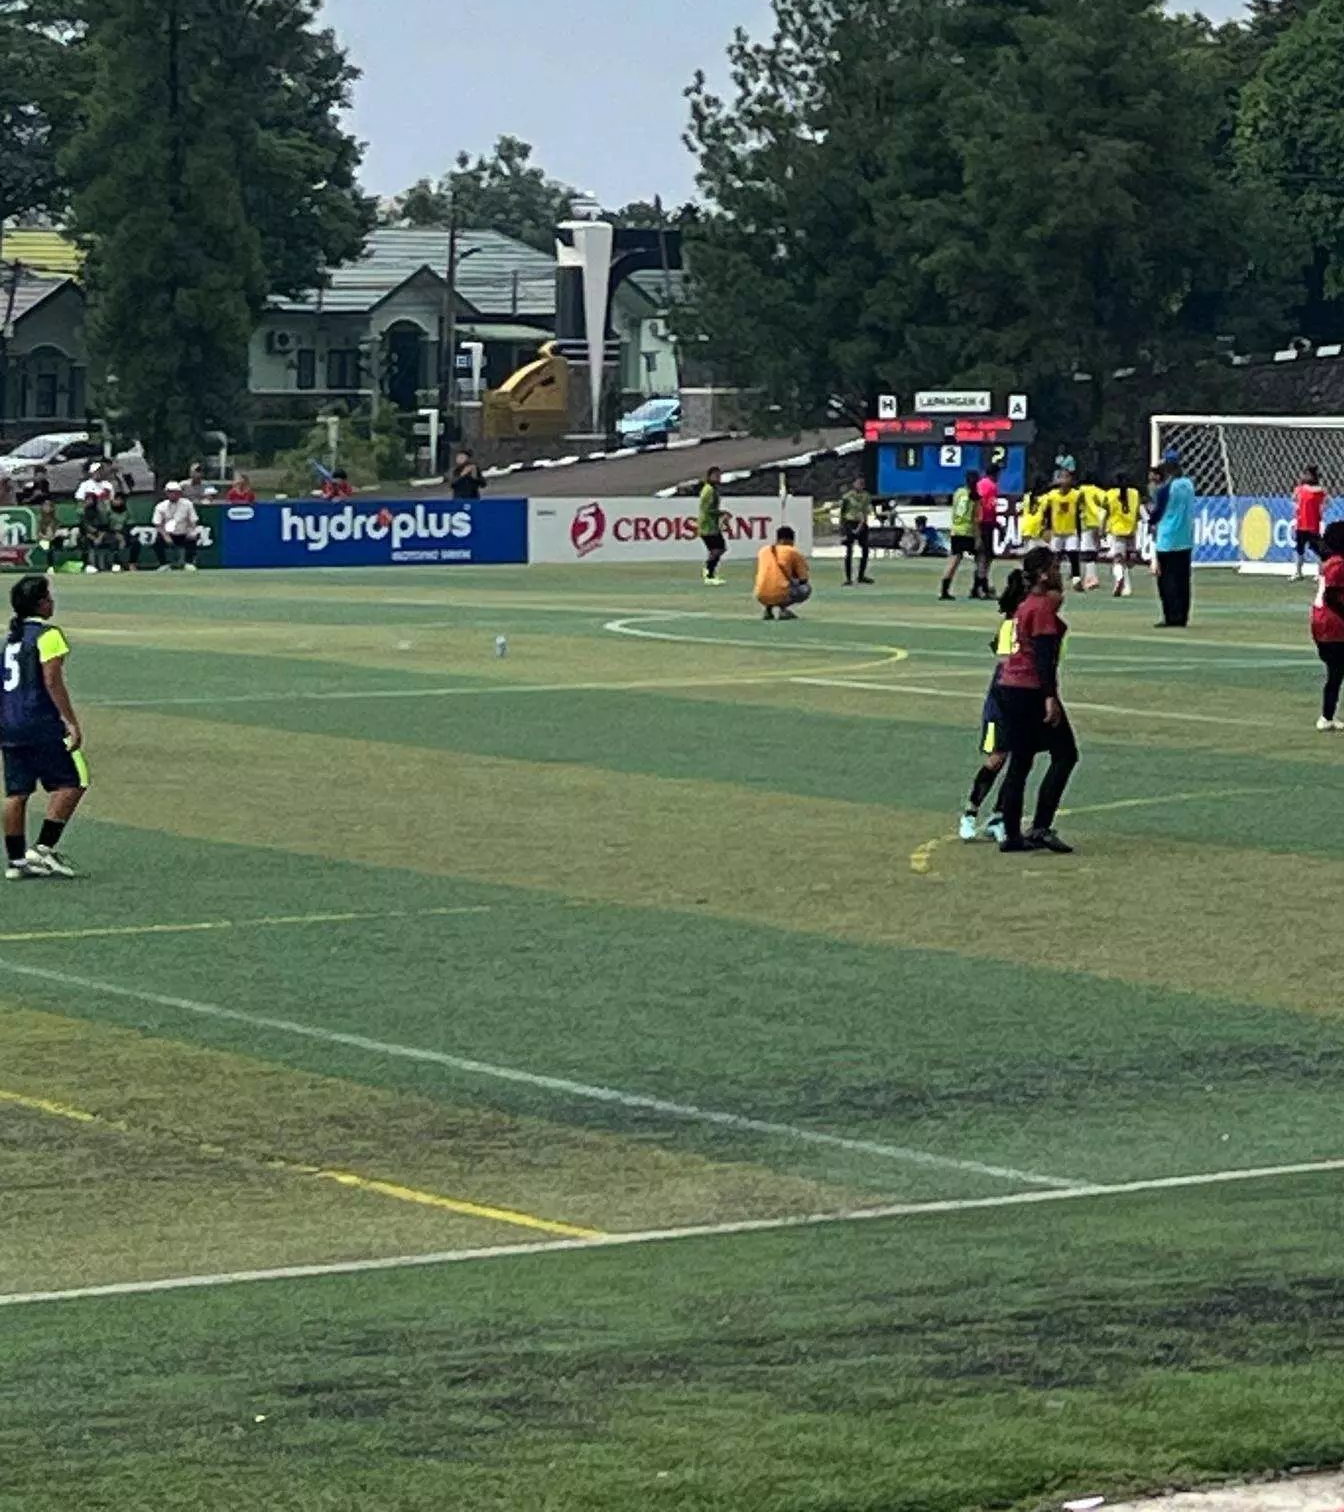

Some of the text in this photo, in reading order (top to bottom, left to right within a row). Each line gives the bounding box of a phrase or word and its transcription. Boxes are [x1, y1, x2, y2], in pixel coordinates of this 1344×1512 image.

[880, 399, 893, 410] H
[1011, 401, 1023, 414] A
[944, 445, 958, 464] 2
[281, 504, 472, 551] hydroplus
[612, 517, 772, 541] CROISANT
[3, 641, 22, 692] 5
